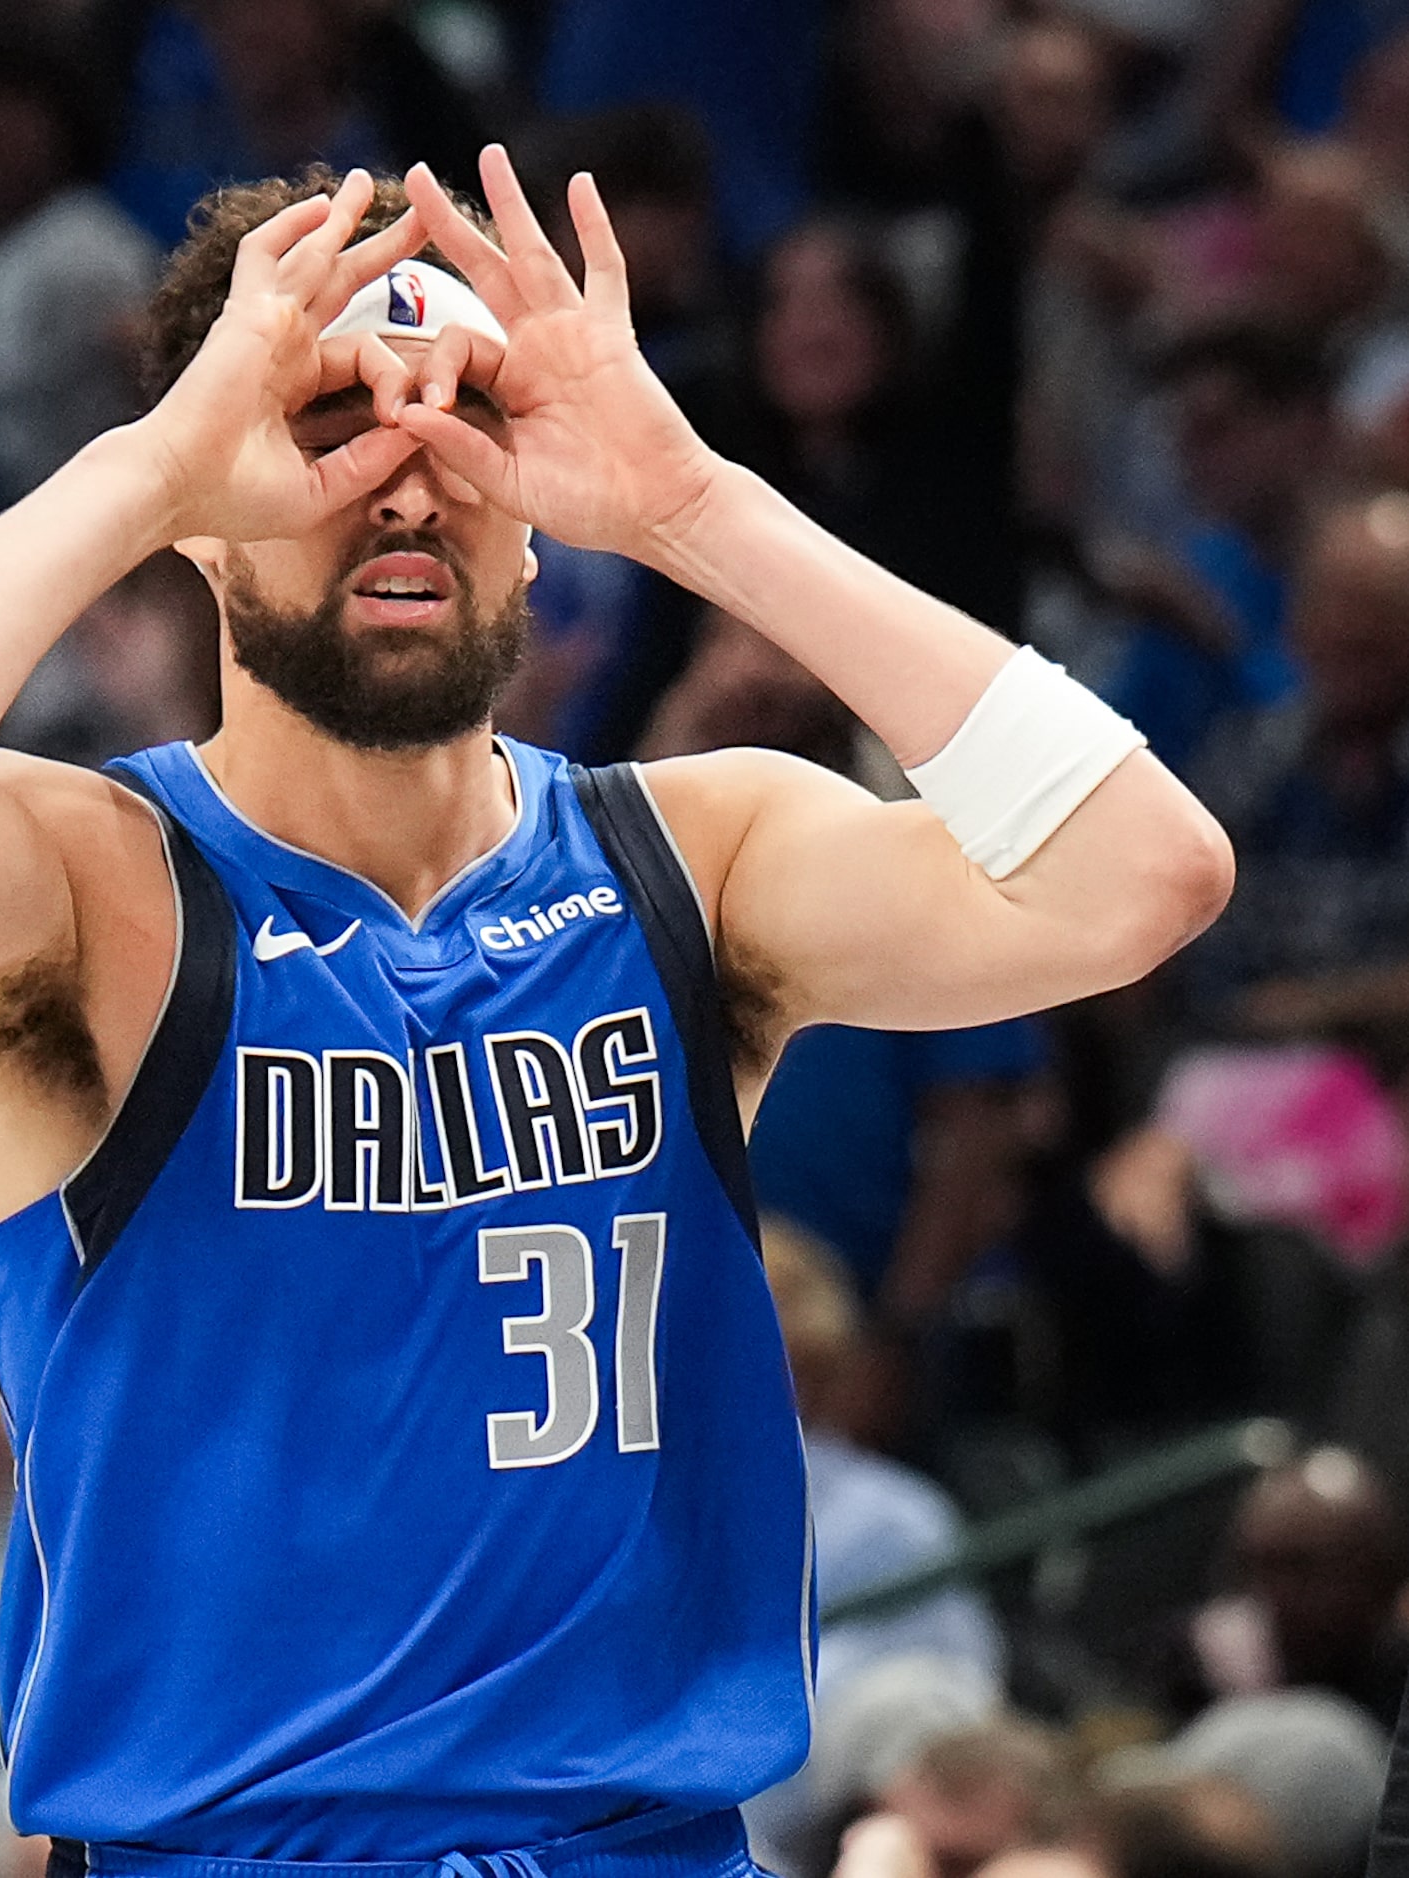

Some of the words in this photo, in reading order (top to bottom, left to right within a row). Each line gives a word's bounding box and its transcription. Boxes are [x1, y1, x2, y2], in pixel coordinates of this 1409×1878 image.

[479, 886, 623, 950] chime
[235, 1006, 663, 1213] DALLAS
[477, 1211, 667, 1470] 31
